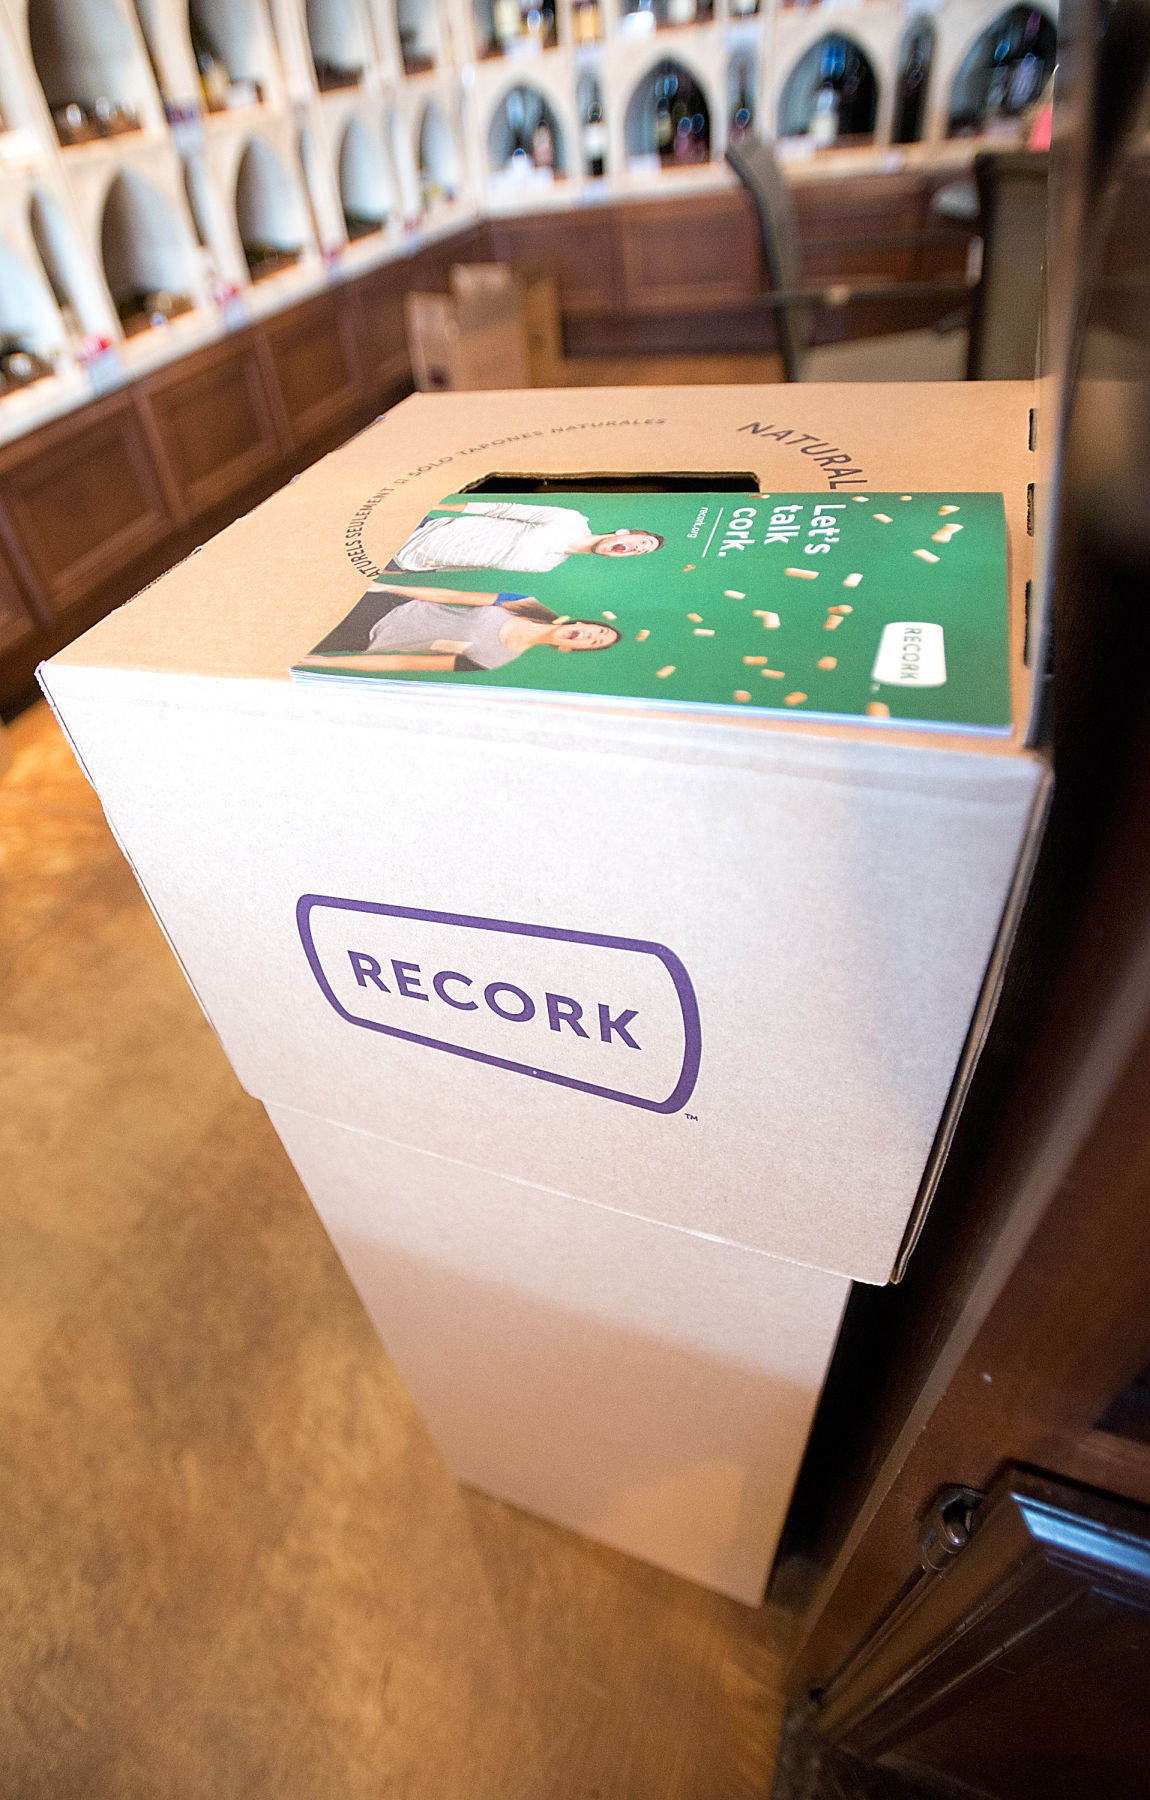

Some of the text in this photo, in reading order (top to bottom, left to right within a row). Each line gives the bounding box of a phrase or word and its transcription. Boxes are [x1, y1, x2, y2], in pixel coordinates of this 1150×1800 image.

[408, 418, 667, 476] SOLO TAPONES NATURALES
[737, 421, 868, 490] NATURAL
[345, 487, 395, 582] ATURELS SEULEMENT
[687, 506, 709, 539] recork.org
[718, 507, 757, 558] cork.
[764, 505, 803, 545] talk
[804, 504, 846, 555] Let's
[899, 627, 923, 680] RECORK
[347, 950, 642, 1050] RECORK
